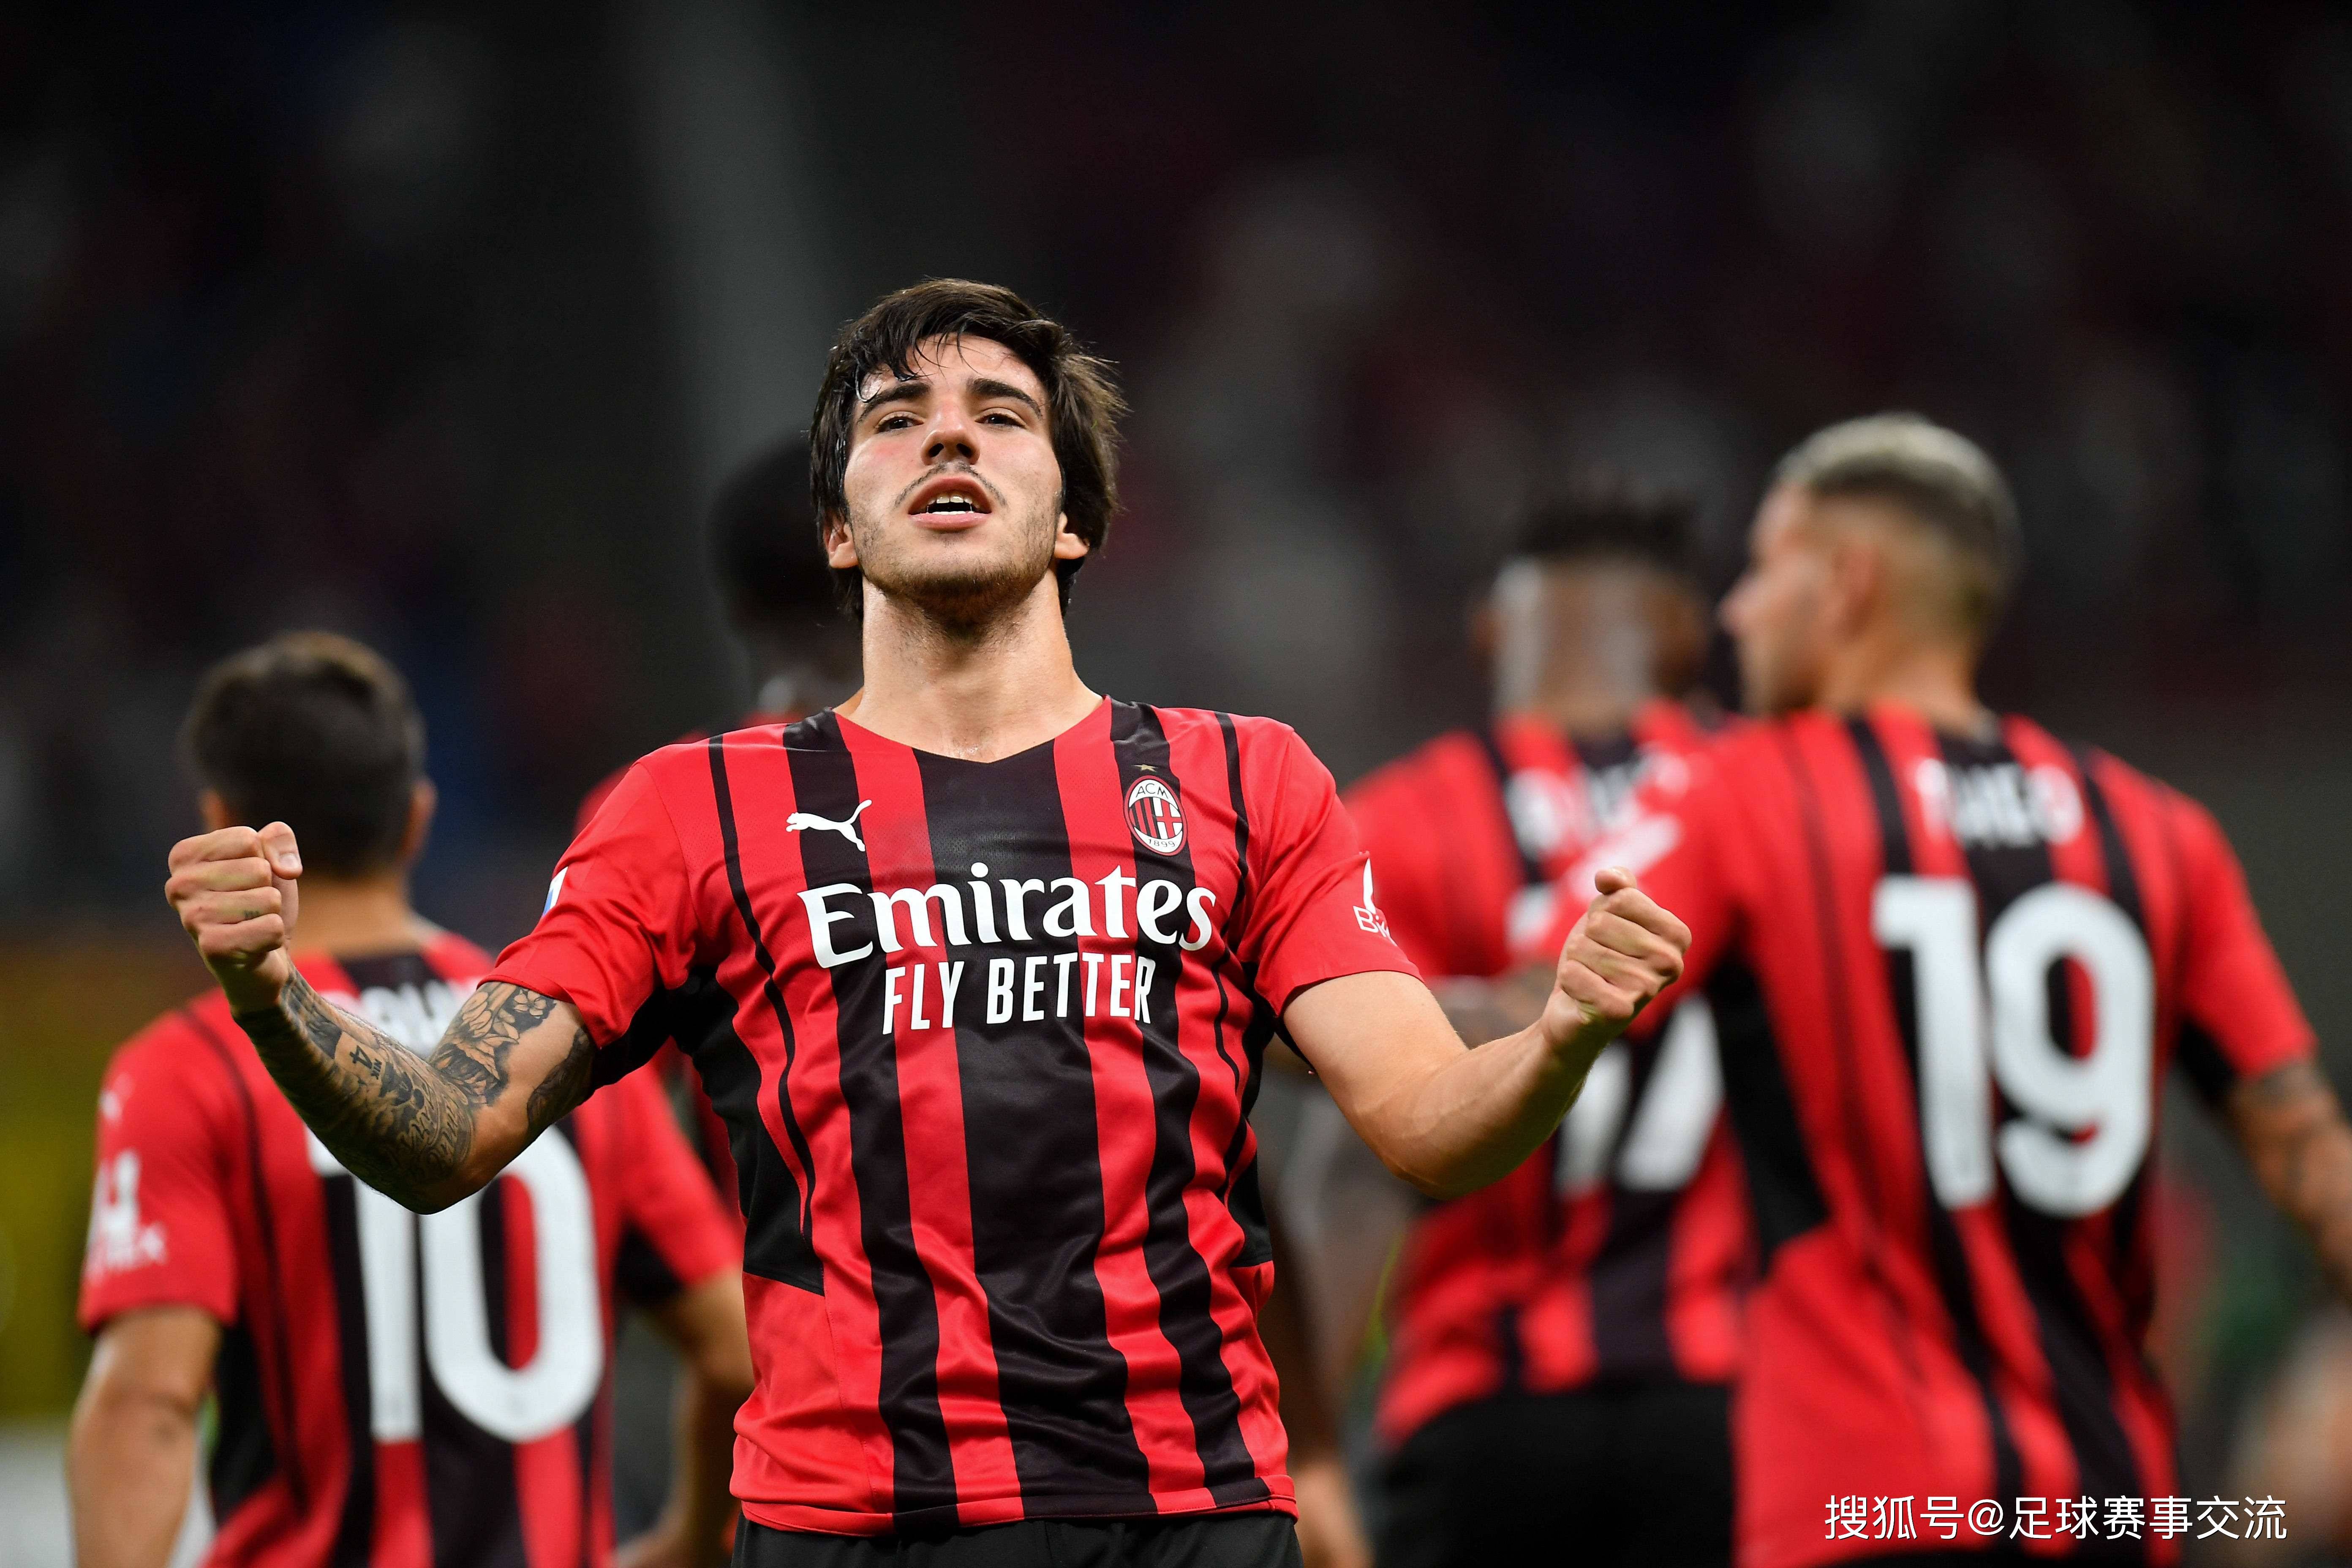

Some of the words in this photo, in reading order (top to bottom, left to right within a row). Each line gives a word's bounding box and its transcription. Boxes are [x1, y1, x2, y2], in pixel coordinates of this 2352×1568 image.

[1135, 783, 1169, 799] ACM
[1148, 838, 1176, 848] 1899
[796, 861, 1217, 969] Emirates
[882, 960, 965, 1035] FLY
[986, 951, 1156, 1025] BETTER
[1872, 874, 2155, 1218] 19
[305, 1122, 604, 1444] 10
